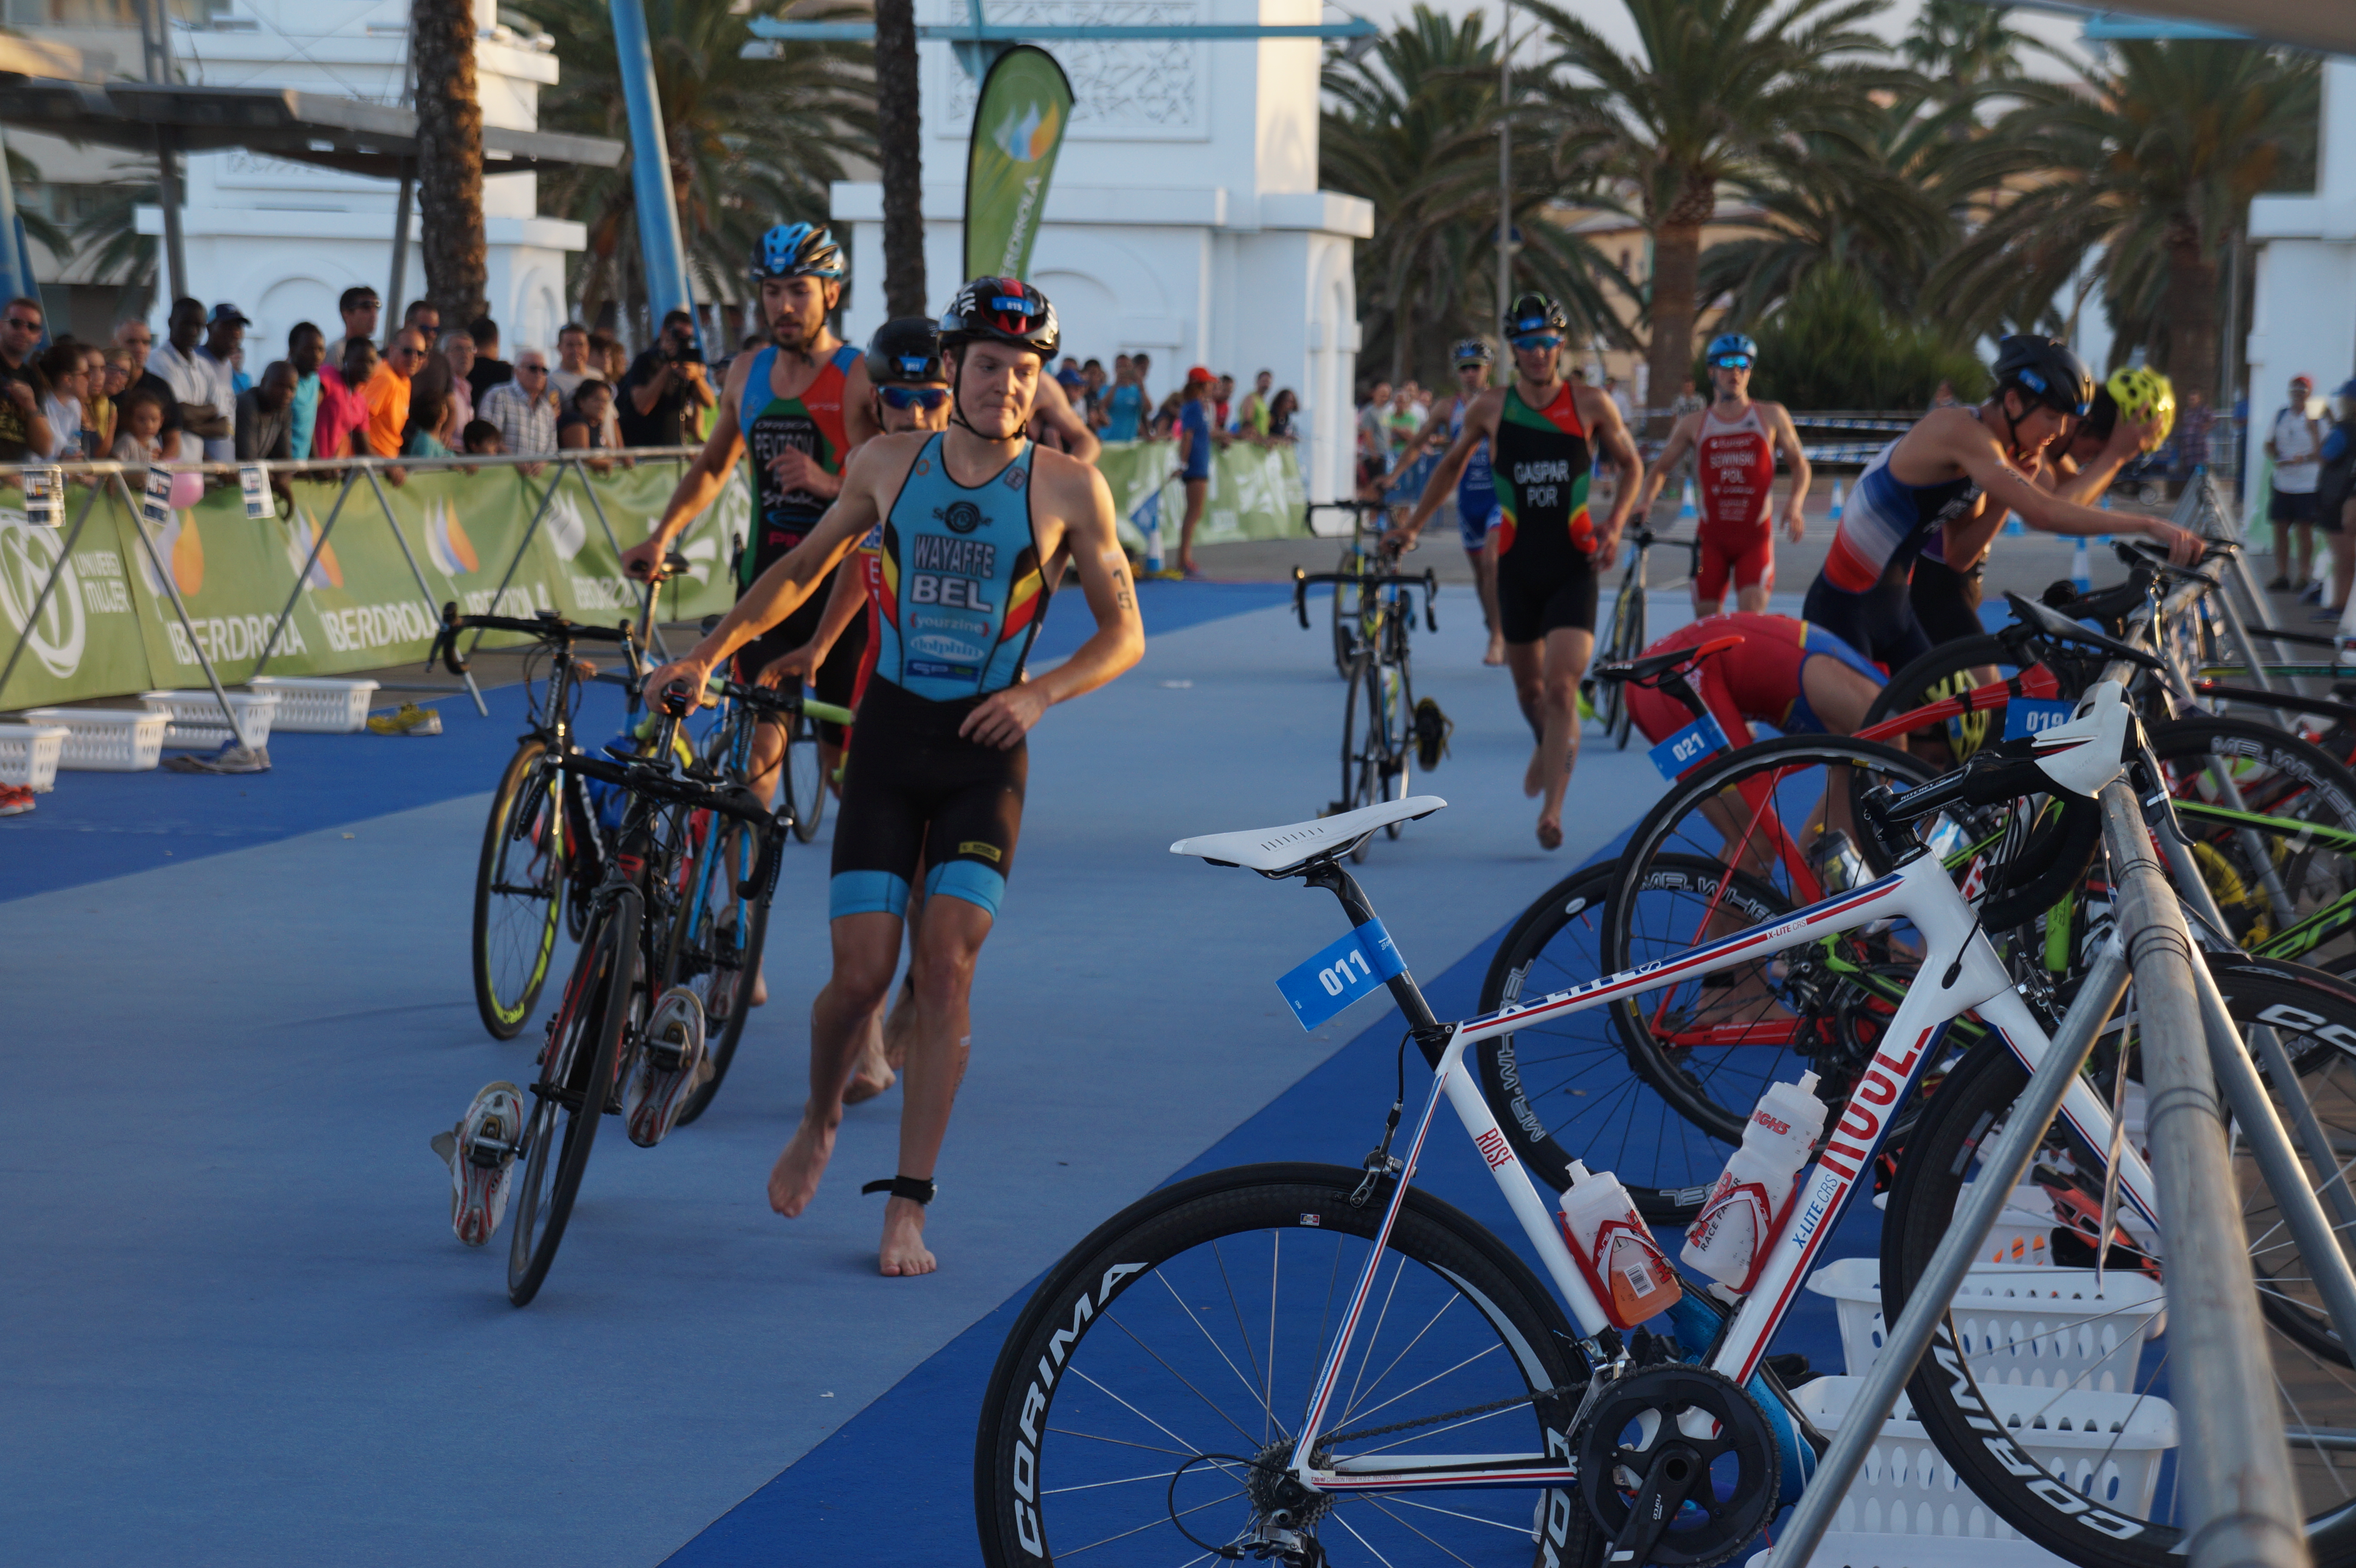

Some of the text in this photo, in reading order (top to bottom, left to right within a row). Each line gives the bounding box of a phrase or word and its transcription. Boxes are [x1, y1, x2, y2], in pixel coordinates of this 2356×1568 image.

[997, 174, 1042, 278] ERDROLA
[1514, 459, 1571, 485] GASPAR
[1720, 467, 1745, 484] POL
[1526, 485, 1558, 508] POR
[914, 535, 994, 578] WAYAFFE
[912, 574, 993, 613] BEL
[2025, 711, 2063, 732] 019
[1672, 731, 1705, 762] 021
[1900, 782, 1936, 801] RITCHEY
[1768, 919, 1807, 940] X-LITE CRS
[1318, 948, 1371, 996] 011
[1475, 1127, 1515, 1173] ROSE
[1793, 1174, 1838, 1250] X-LITE CRS
[1597, 1231, 1611, 1258] ELITE
[1700, 1221, 1720, 1252] RACE
[1013, 1262, 1149, 1559] CORIMA
